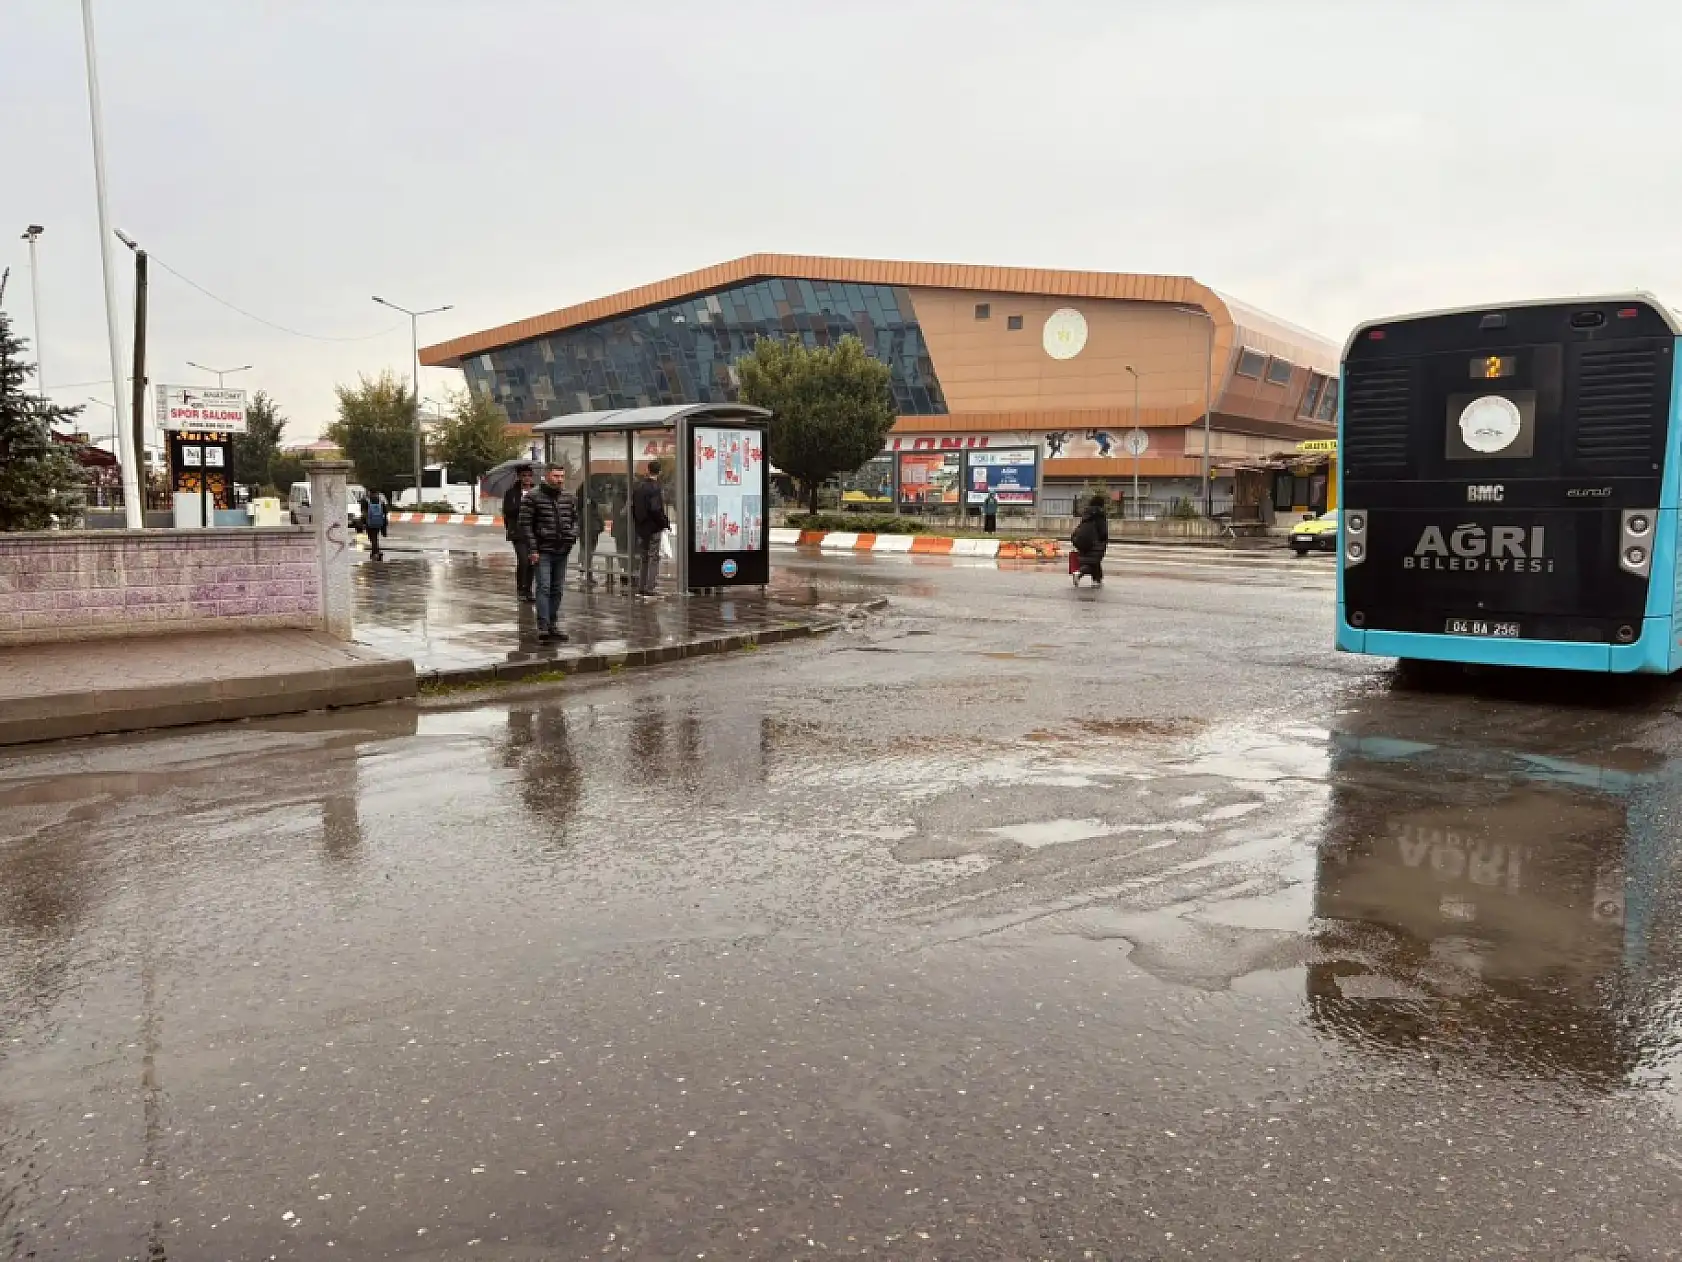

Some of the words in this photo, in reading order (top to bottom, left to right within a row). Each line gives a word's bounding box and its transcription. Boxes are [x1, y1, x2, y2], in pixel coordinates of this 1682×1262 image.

[1485, 356, 1502, 379] 2
[170, 408, 200, 419] SPOR
[202, 409, 243, 421] SALONU
[1467, 484, 1505, 502] BMC
[1414, 522, 1545, 558] AĞRI
